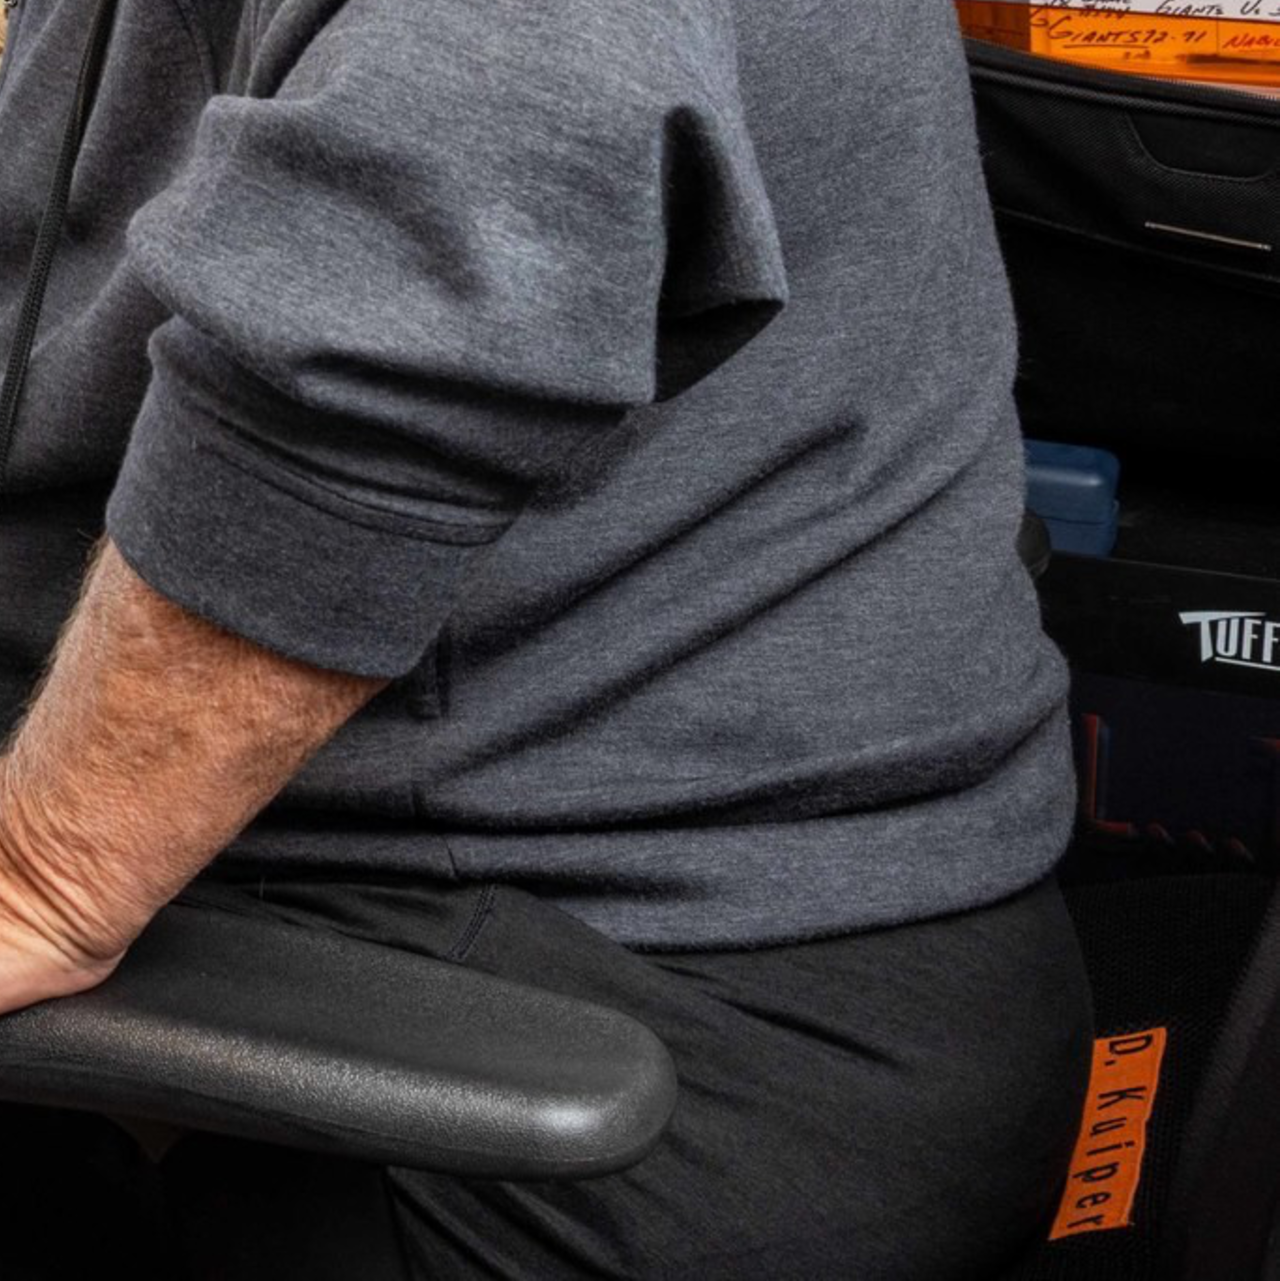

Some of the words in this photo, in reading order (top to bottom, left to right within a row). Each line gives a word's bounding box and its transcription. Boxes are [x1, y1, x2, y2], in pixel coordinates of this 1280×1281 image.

[1178, 611, 1280, 663] TUFF
[1104, 1033, 1154, 1067] D.
[1066, 1084, 1147, 1228] Kuiper
